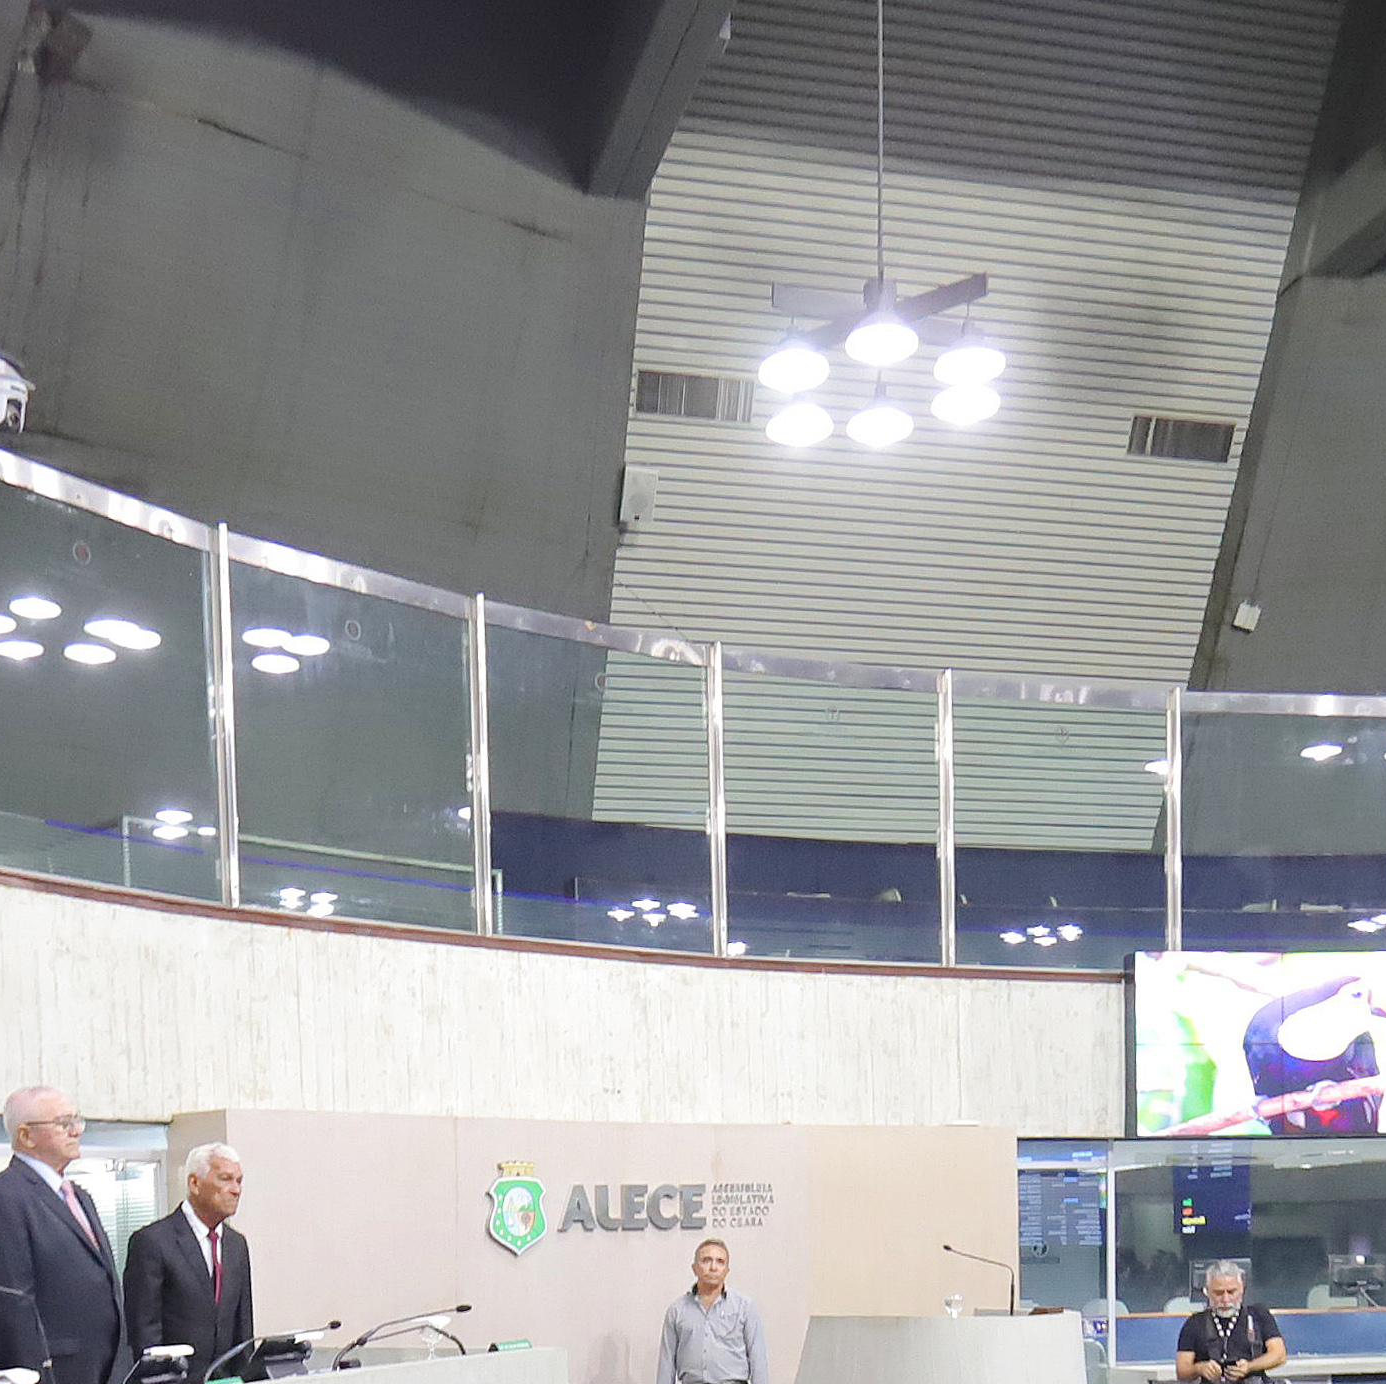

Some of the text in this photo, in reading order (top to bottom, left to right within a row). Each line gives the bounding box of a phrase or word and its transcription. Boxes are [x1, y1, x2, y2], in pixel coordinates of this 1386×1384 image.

[711, 1194, 775, 1206] LEGISLATIVA
[557, 1183, 707, 1232] ALECE
[711, 1206, 770, 1217] DO ESTADO
[711, 1218, 727, 1228] DO
